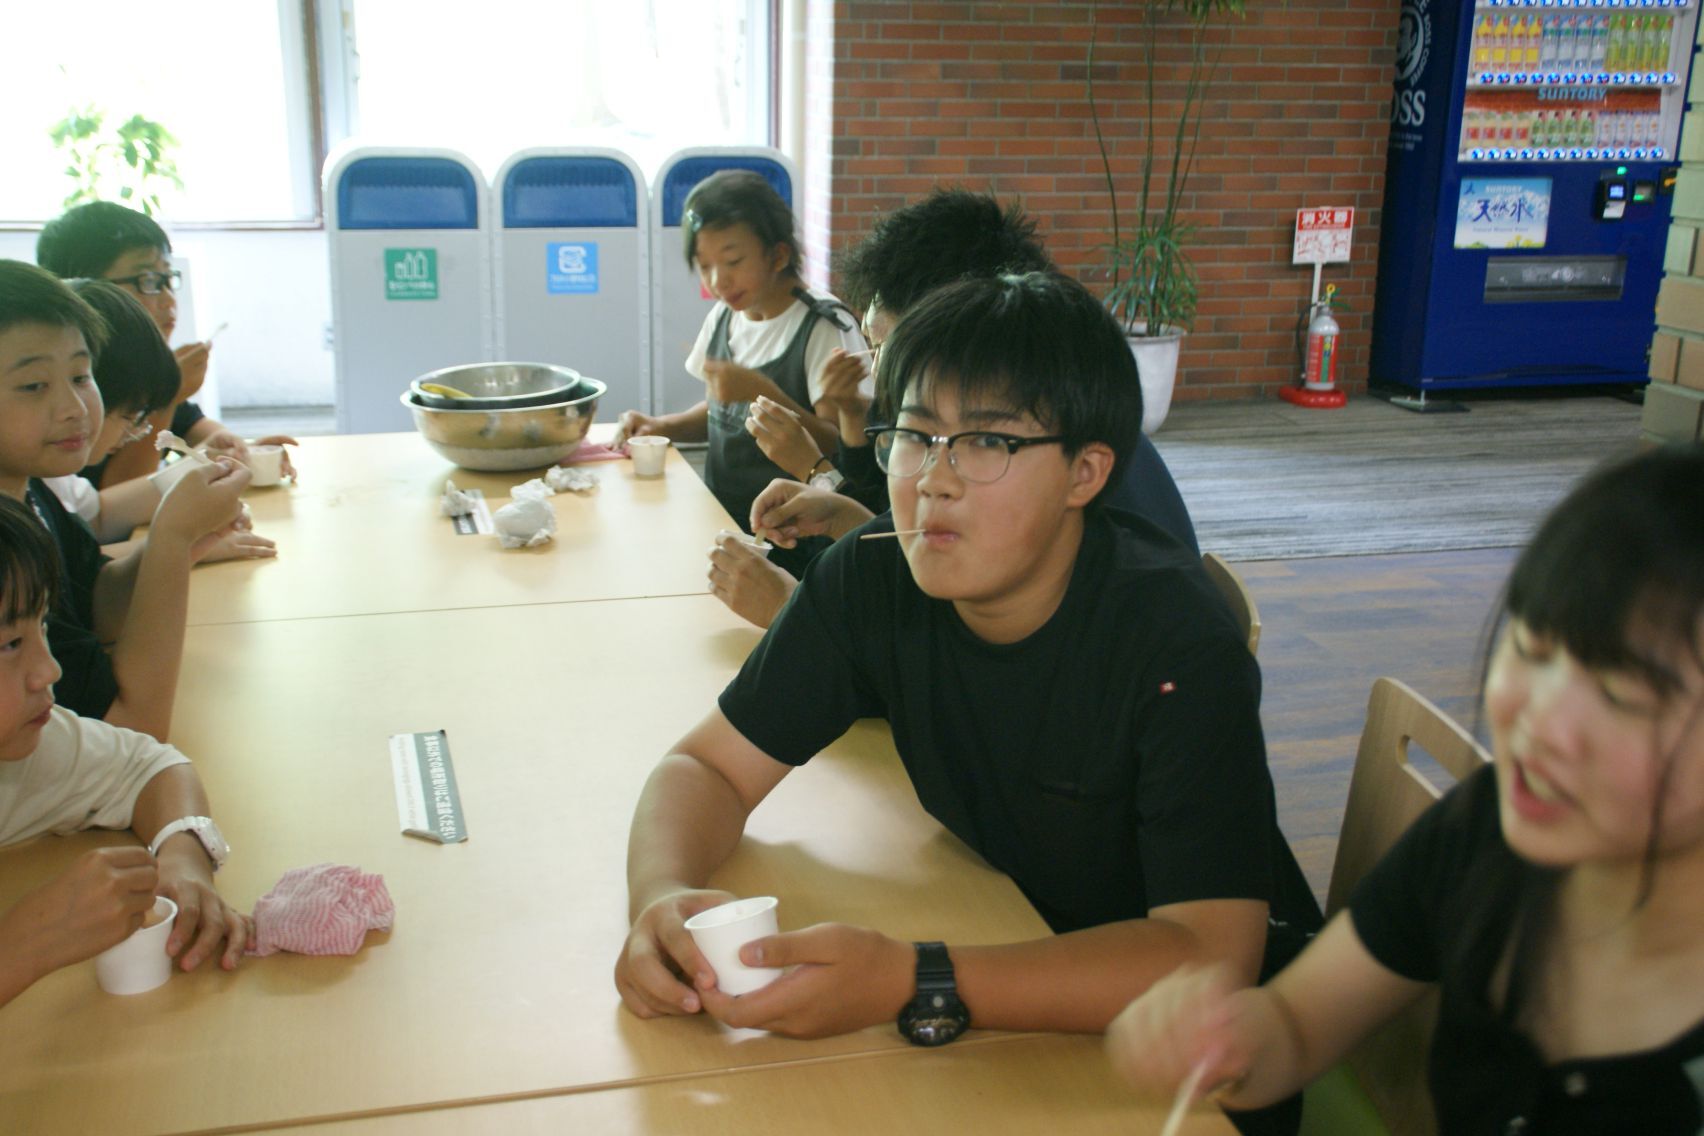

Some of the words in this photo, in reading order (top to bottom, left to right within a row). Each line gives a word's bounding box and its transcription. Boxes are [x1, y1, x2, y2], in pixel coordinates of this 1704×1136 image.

[1537, 86, 1608, 101] SUNTORY
[1472, 198, 1534, 224] 天然水
